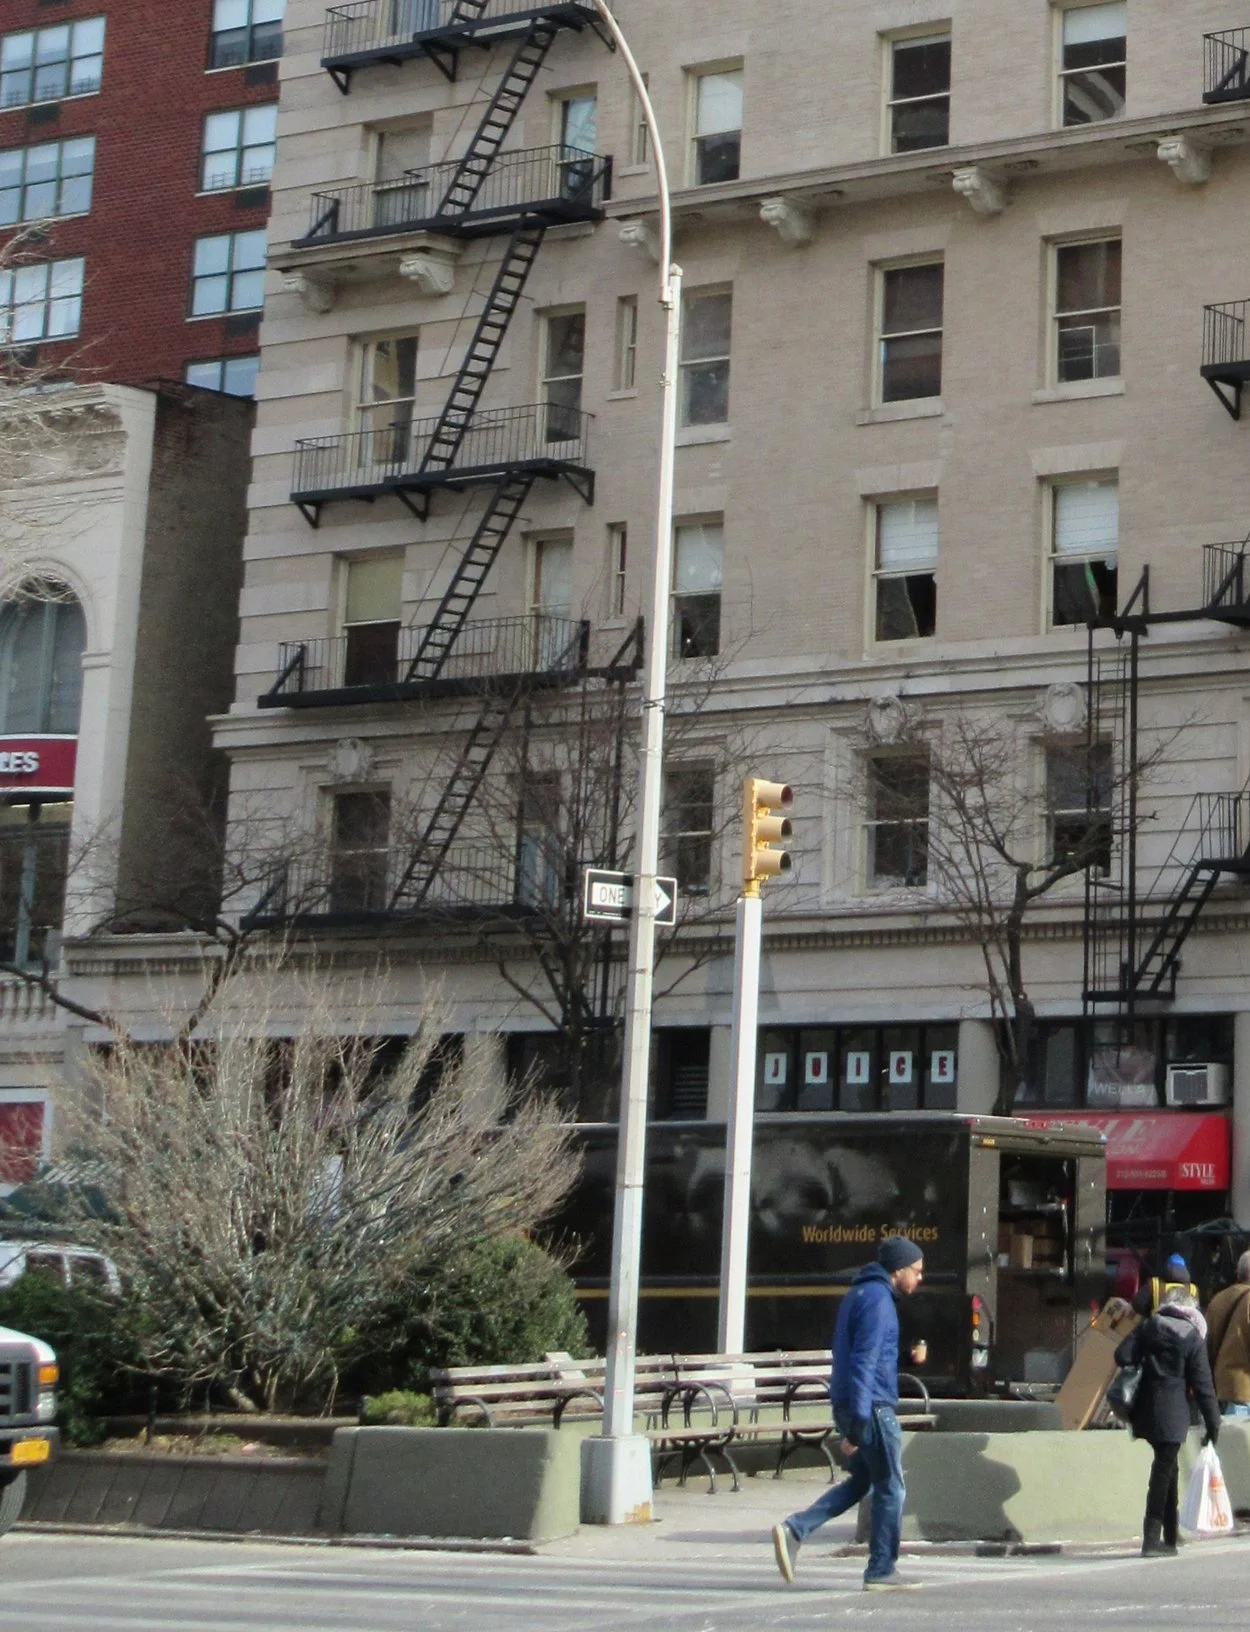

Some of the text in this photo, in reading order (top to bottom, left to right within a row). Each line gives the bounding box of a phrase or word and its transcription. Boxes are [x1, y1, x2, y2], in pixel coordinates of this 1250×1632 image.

[600, 886, 624, 905] ONE
[1181, 1163, 1216, 1178] STYLE
[802, 1224, 876, 1243] Worldwide
